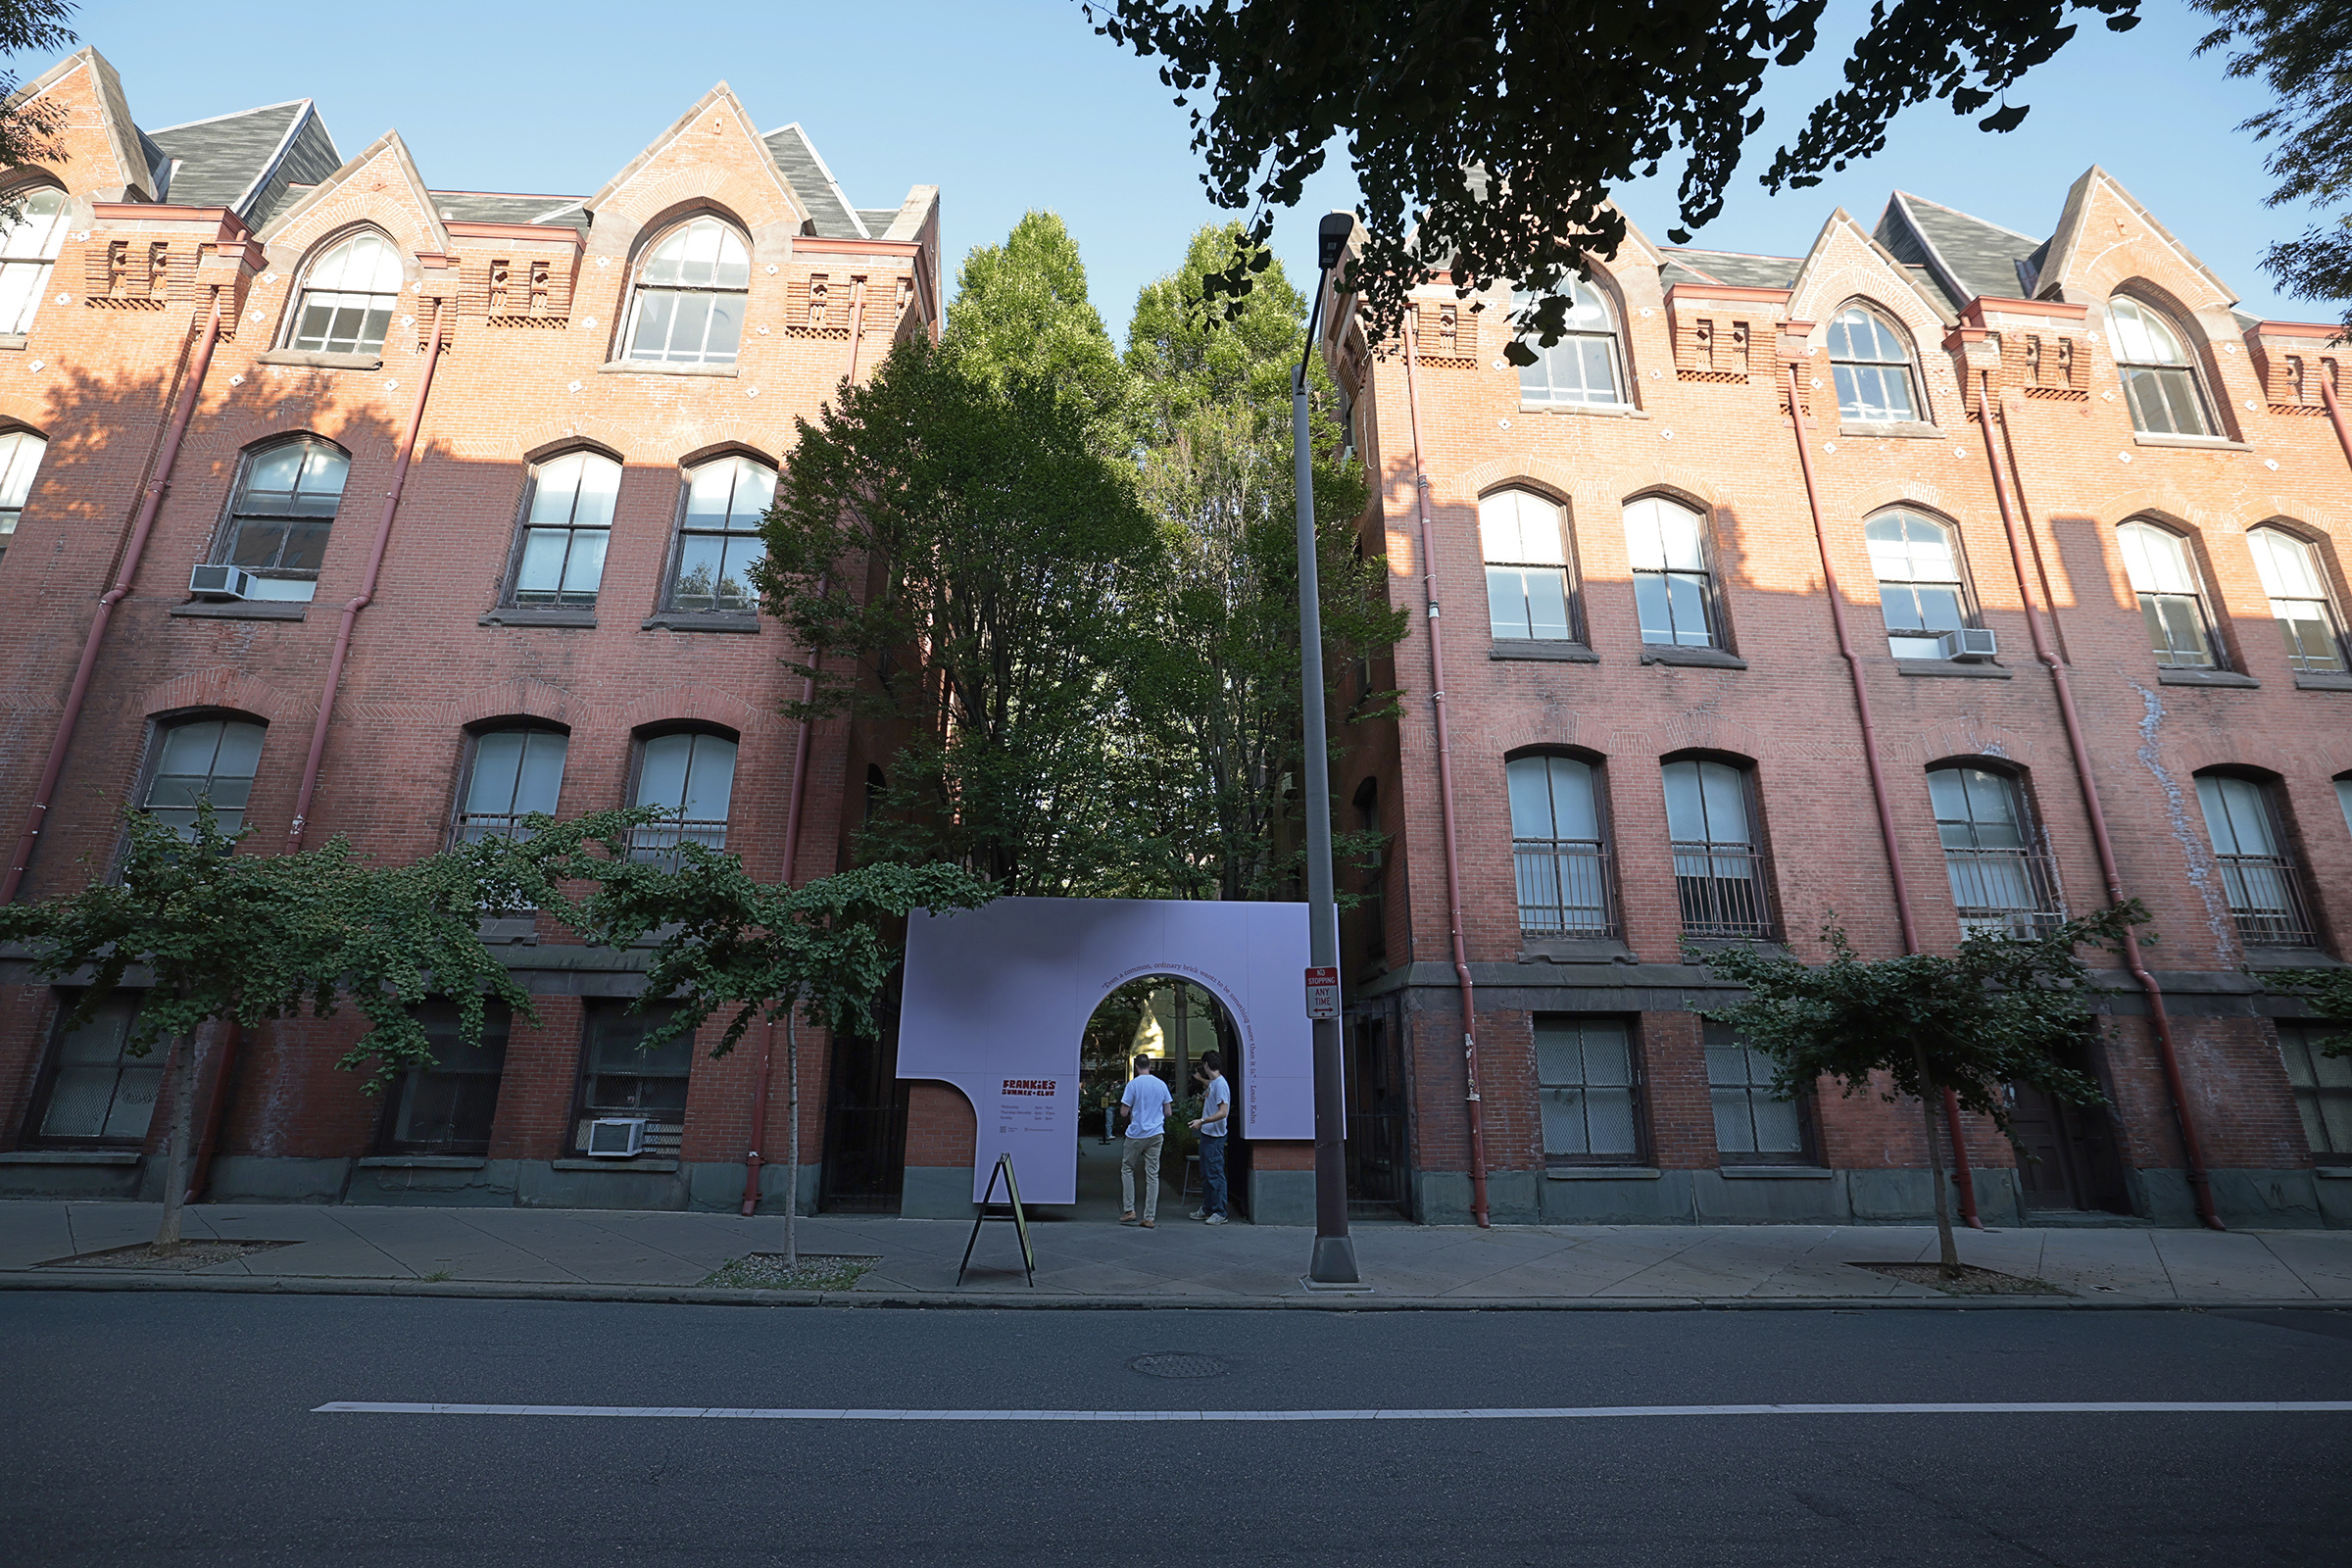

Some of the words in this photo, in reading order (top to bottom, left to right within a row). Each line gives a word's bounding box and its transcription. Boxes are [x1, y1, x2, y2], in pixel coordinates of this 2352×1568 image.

[1308, 976, 1336, 985] STOPPING
[1124, 964, 1152, 976] common,
[1153, 961, 1181, 970] ordinary
[1183, 963, 1199, 974] brick
[1200, 970, 1217, 983] wants
[1223, 985, 1231, 994] be
[1229, 993, 1250, 1024] something
[1315, 988, 1330, 997] ANY
[1315, 997, 1332, 1005] TIME
